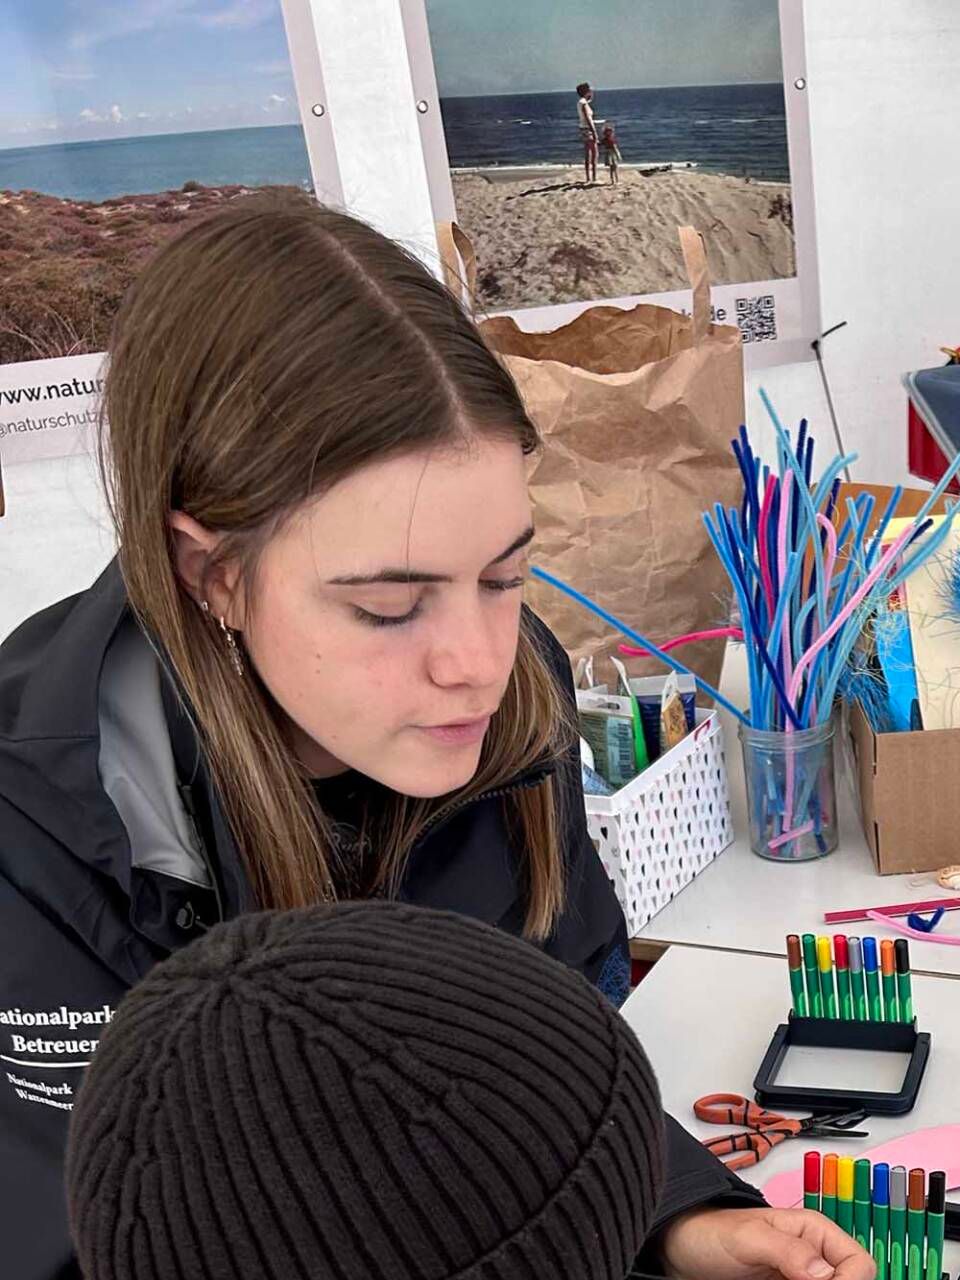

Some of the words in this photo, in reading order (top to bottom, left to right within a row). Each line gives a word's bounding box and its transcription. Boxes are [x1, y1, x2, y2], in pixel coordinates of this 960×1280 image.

[0, 378, 104, 405] ww.natur
[11, 1034, 99, 1054] Betreuer
[6, 1072, 73, 1096] Nationalpark
